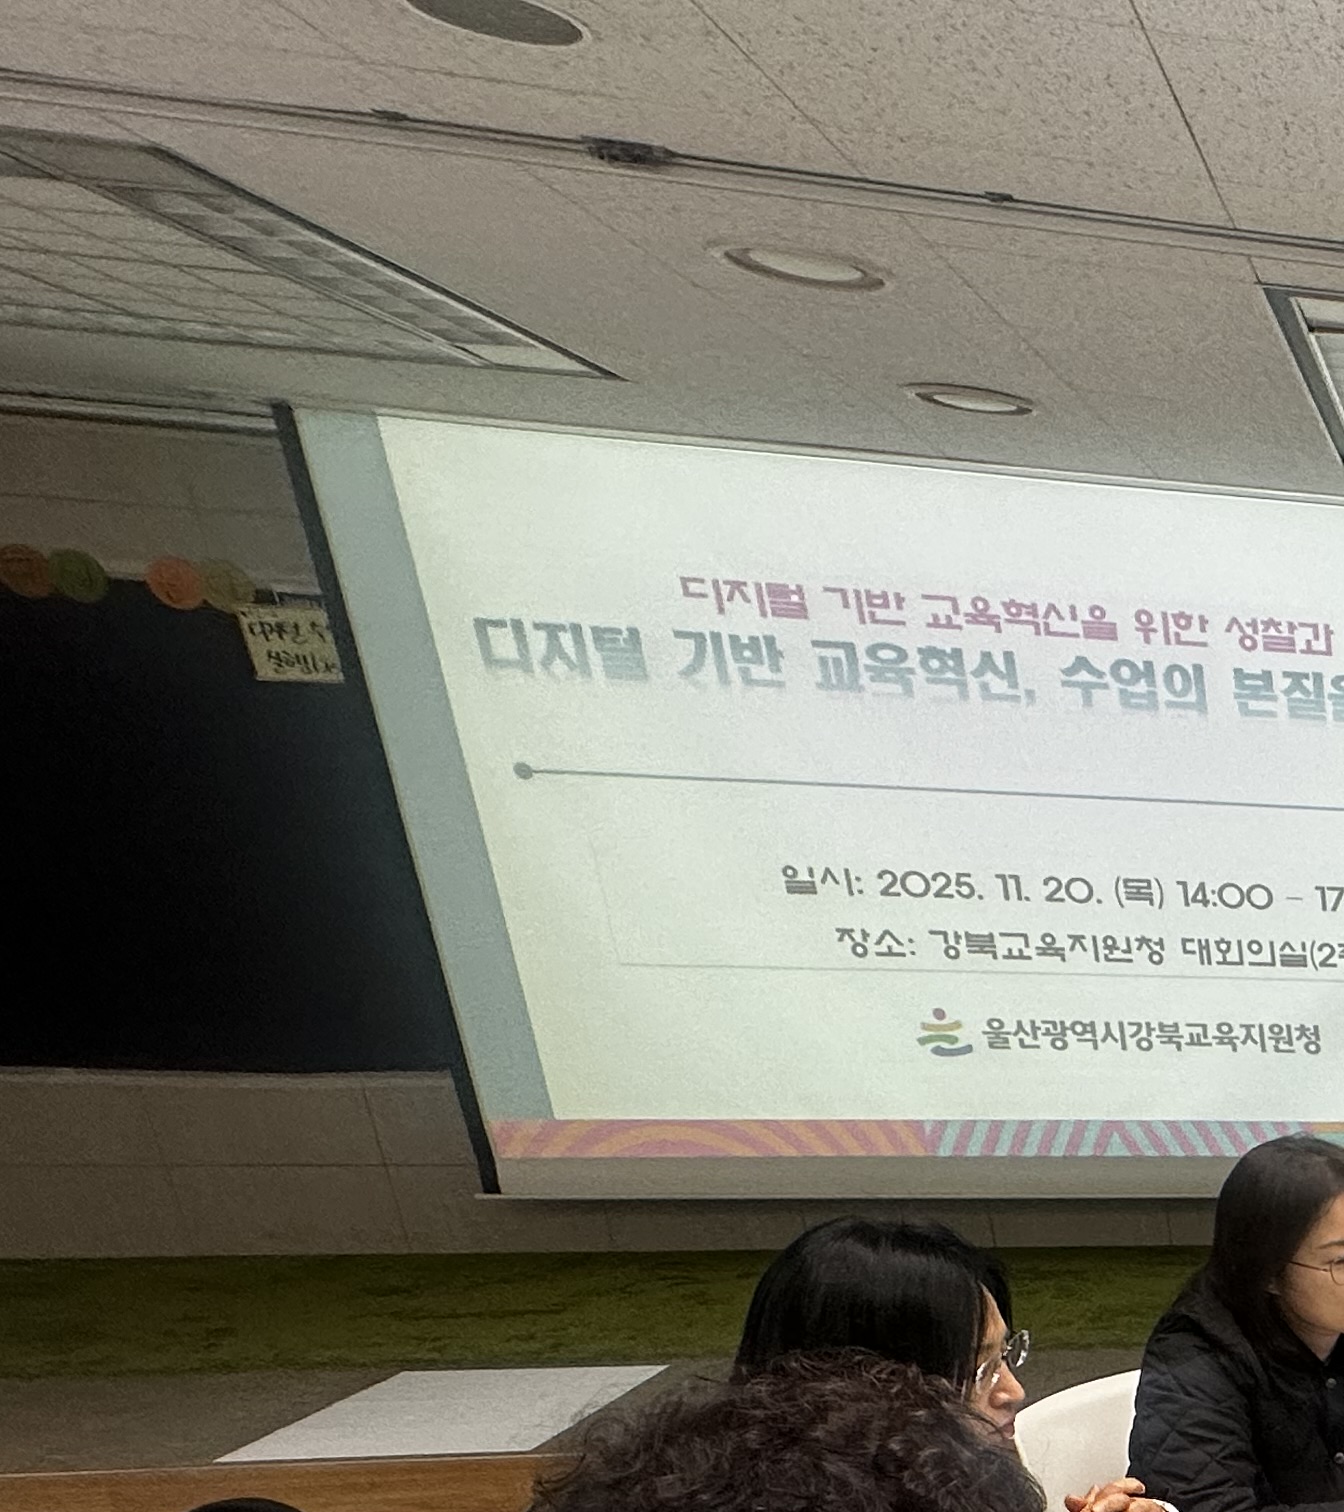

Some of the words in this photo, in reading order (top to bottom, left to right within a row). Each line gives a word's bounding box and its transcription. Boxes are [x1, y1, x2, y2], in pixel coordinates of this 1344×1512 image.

[679, 576, 808, 620] 디지털
[823, 586, 906, 626] 기반
[921, 593, 1118, 642] 교육혁신을
[1135, 608, 1208, 648] 위한
[1225, 616, 1334, 657] 성찰과
[473, 616, 650, 683] 디지털
[673, 629, 785, 688] 기반
[811, 639, 1037, 707] 교육혁신,
[1060, 655, 1208, 715] 수업의
[782, 864, 864, 897] 일시:
[877, 869, 984, 900] 2025.
[995, 873, 1031, 901] 11.
[1042, 876, 1102, 904] 20.
[1114, 875, 1164, 909] (목)
[1176, 880, 1274, 910] 14:00
[835, 927, 915, 958] 장소:
[928, 929, 1165, 966] 강북교육지원청
[981, 1017, 1322, 1055] 울산광역시강북교육지원청
